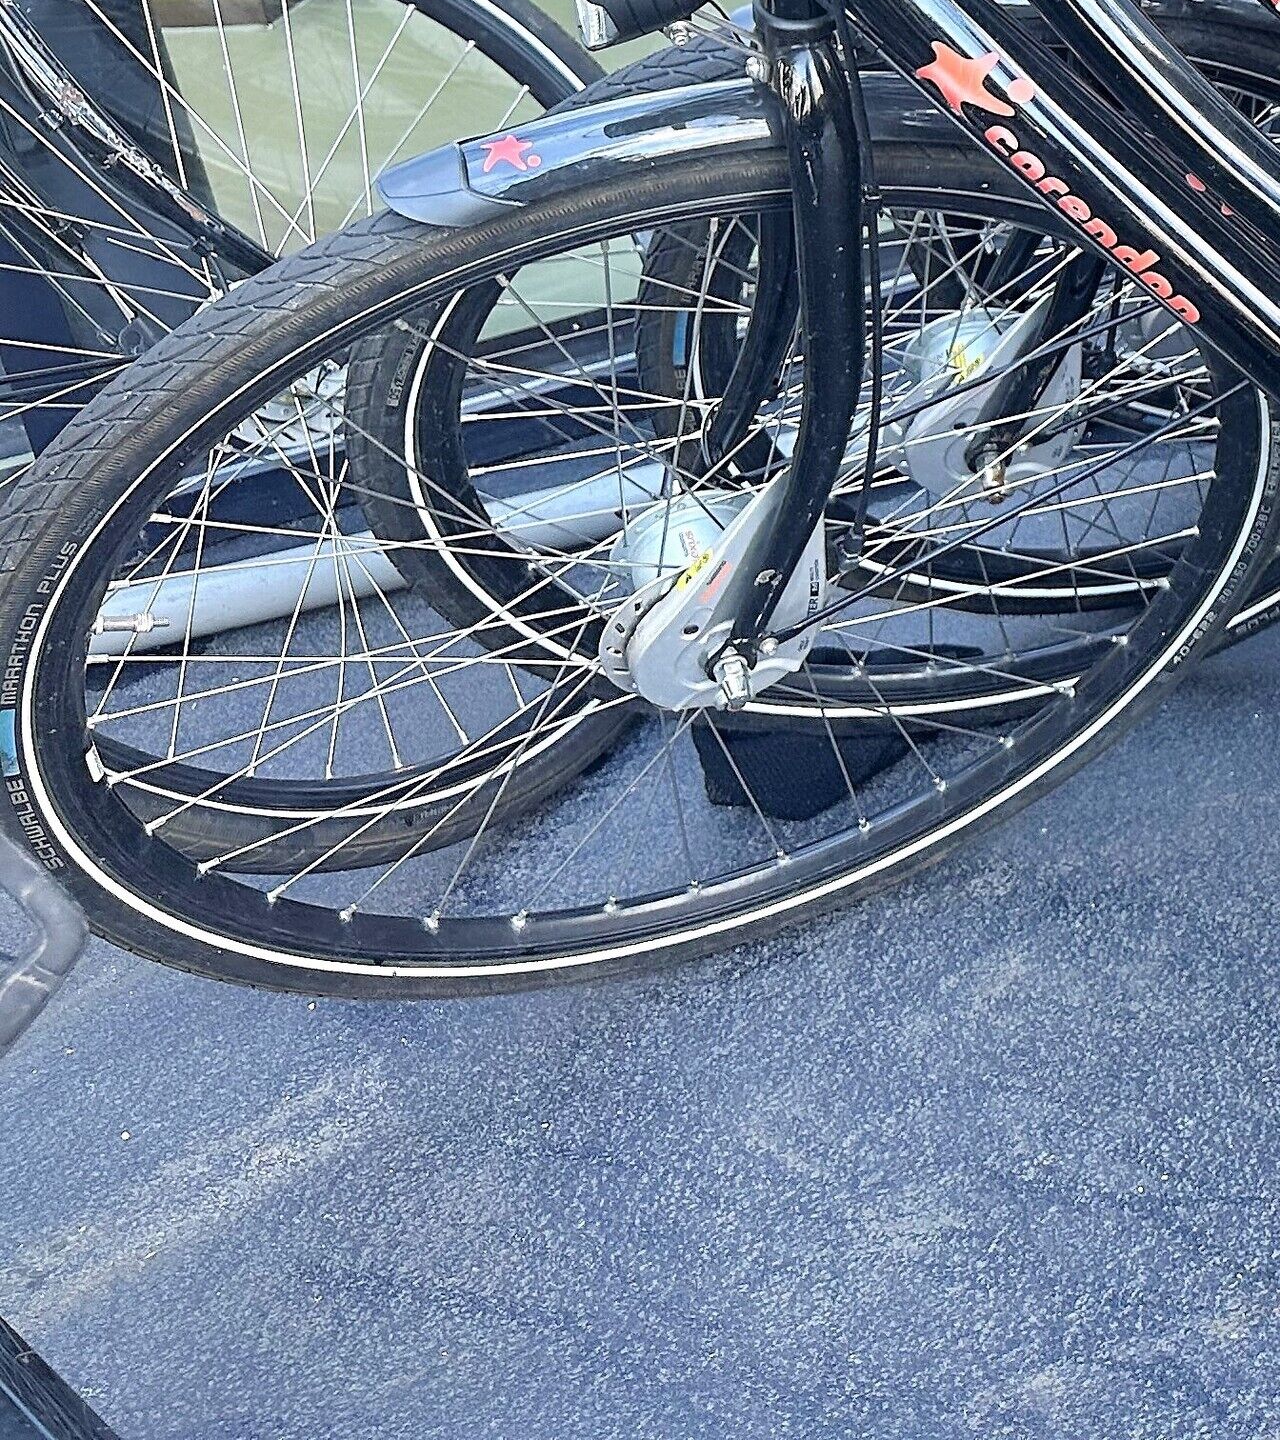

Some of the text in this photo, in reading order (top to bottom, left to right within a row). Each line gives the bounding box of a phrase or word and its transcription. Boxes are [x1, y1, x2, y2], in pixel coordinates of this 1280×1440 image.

[984, 125, 1201, 323] corendon
[1, 541, 78, 870] SCHWALBE MARATHON PLUS
